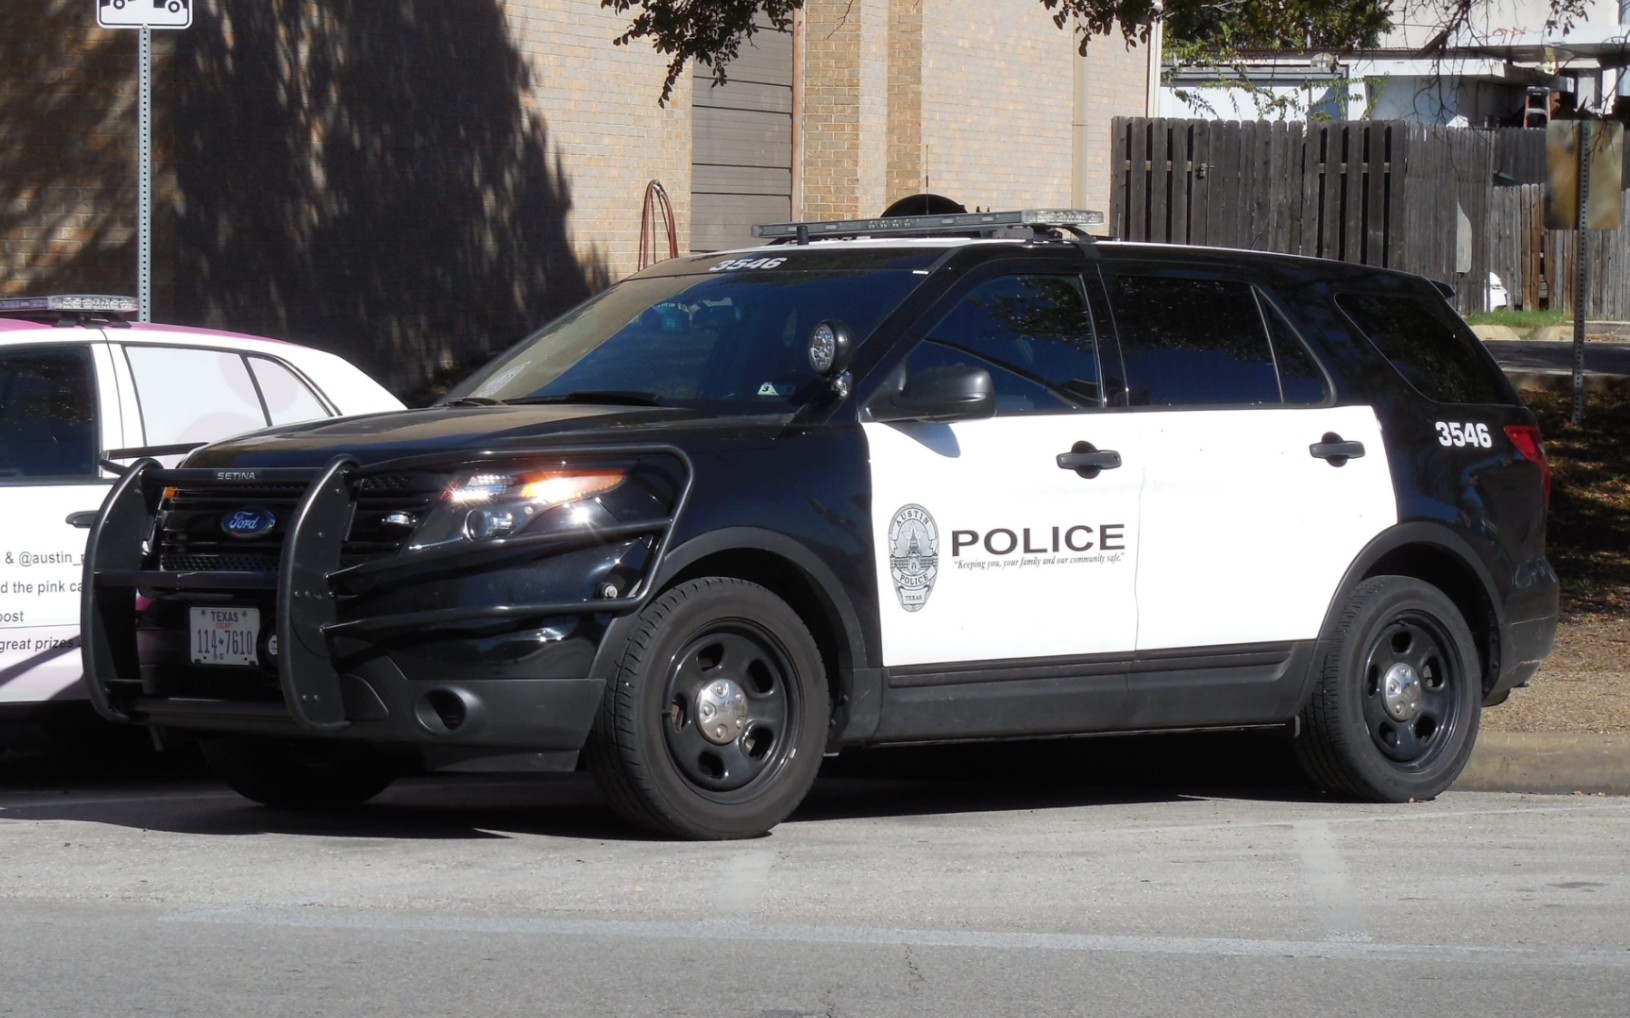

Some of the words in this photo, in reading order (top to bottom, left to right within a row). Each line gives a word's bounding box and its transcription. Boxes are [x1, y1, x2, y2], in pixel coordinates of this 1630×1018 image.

[708, 257, 788, 271] 3546
[1435, 421, 1492, 448] 3546
[217, 471, 257, 480] SETINA
[229, 511, 260, 529] Ford
[896, 510, 930, 527] AUSTIN
[951, 523, 1126, 557] POLICE
[5, 551, 14, 564] &
[1002, 559, 1019, 571] your
[1019, 556, 1041, 569] family
[1042, 555, 1057, 566] and
[1056, 557, 1069, 565] our
[1069, 553, 1106, 565] community
[900, 574, 929, 585] POLICE
[13, 581, 33, 593] the
[38, 580, 66, 596] pink
[210, 610, 239, 623] TEXAS
[0, 637, 31, 653] great
[34, 636, 74, 652] prizes
